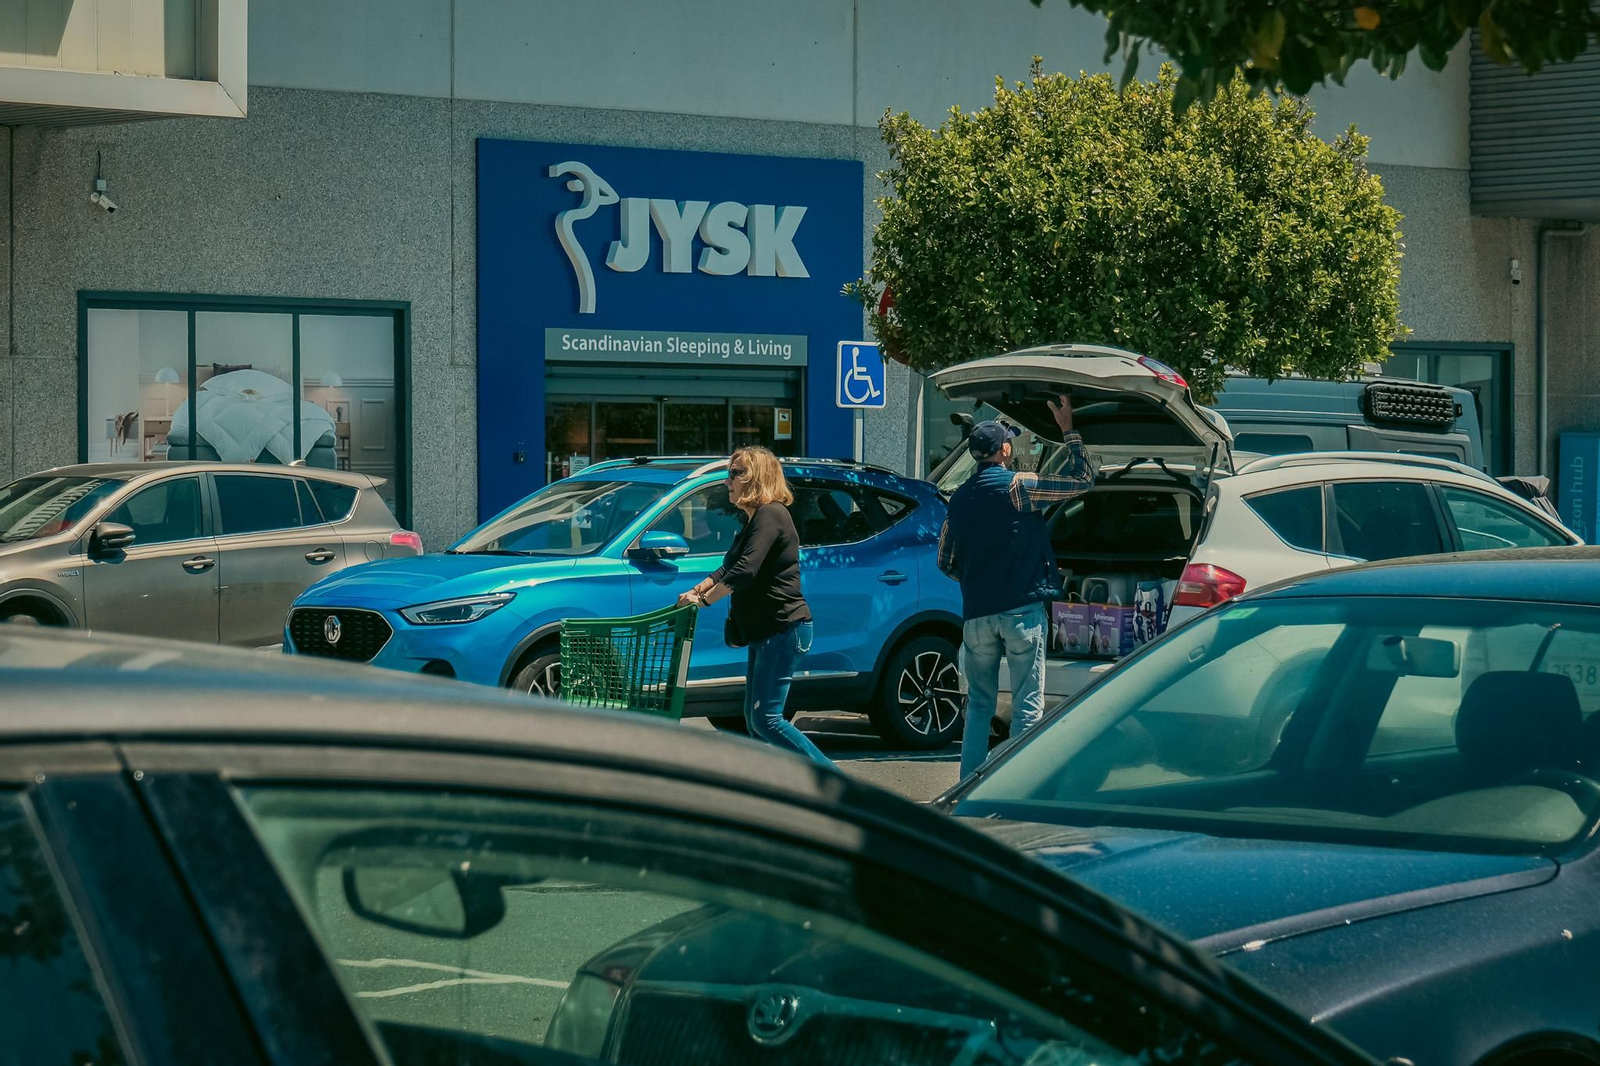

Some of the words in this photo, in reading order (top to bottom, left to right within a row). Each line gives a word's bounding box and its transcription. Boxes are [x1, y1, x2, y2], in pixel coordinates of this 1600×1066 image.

[605, 197, 810, 278] JYSK
[561, 334, 662, 353] Scandinavian
[666, 337, 730, 358] Sleeping
[733, 339, 744, 355] &
[748, 340, 792, 360] Living
[1569, 456, 1584, 493] hub
